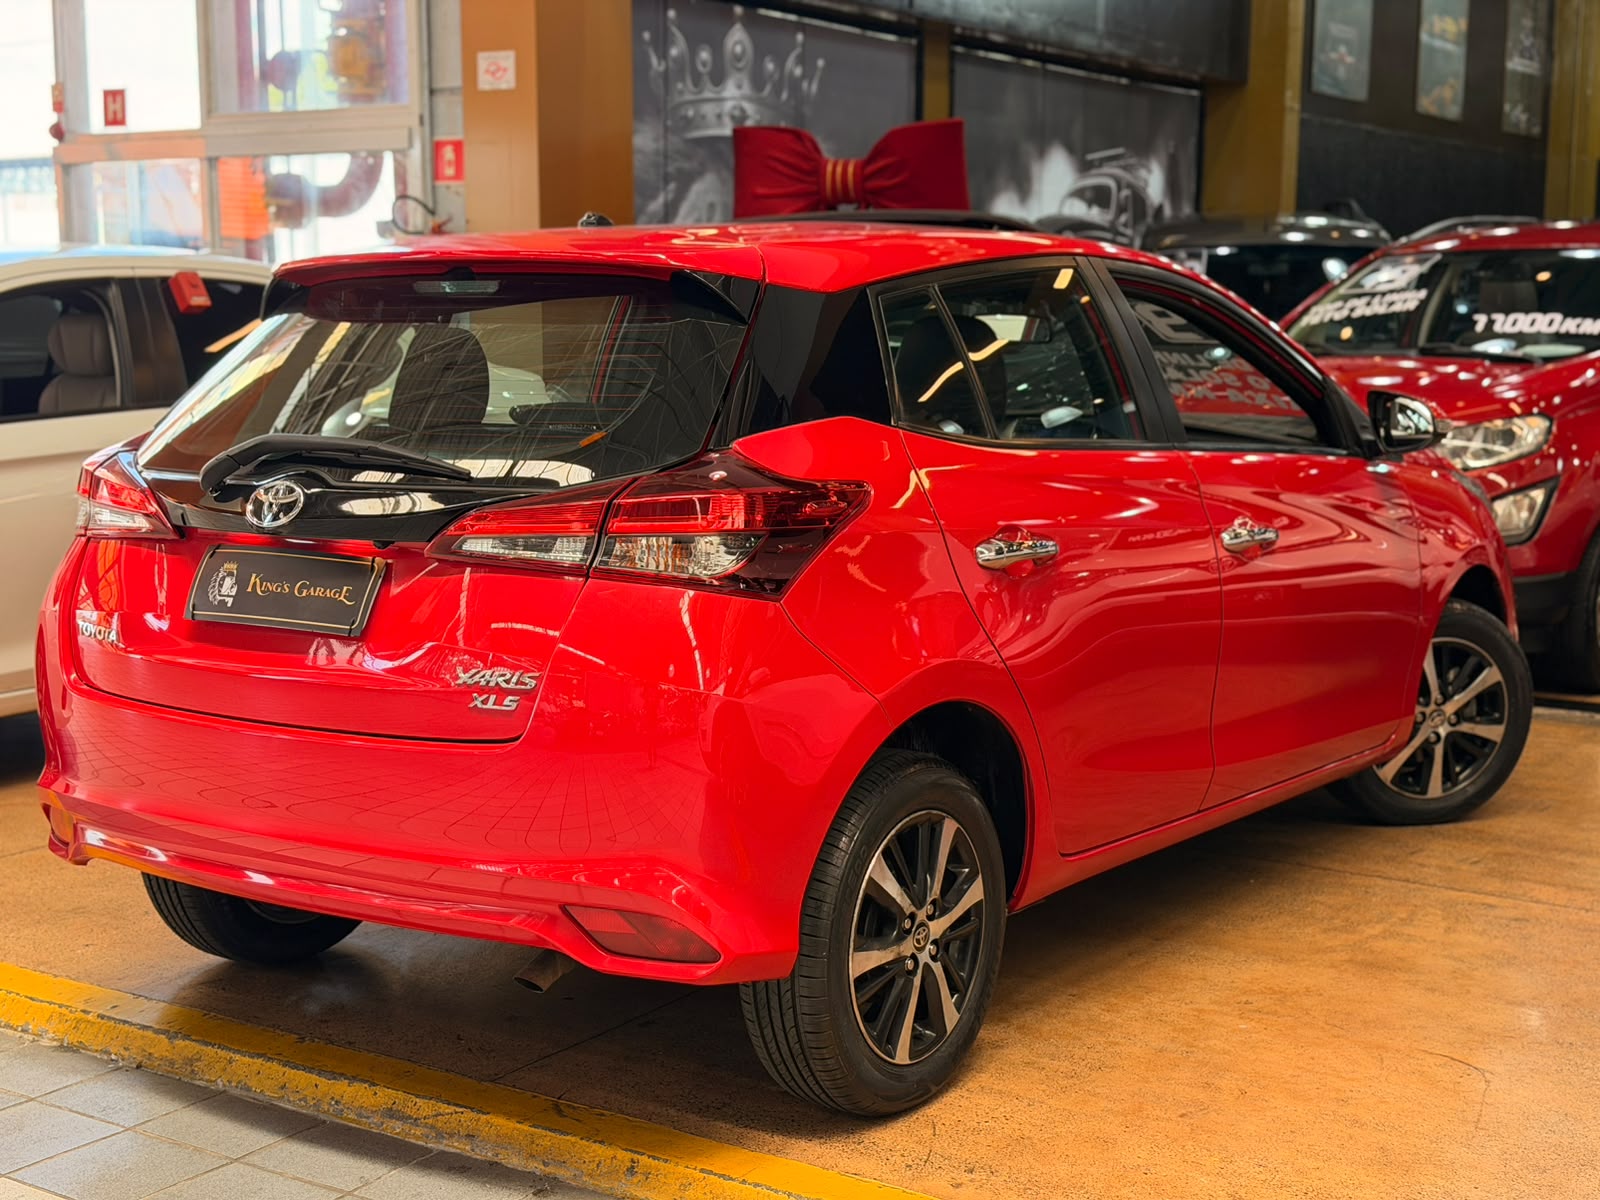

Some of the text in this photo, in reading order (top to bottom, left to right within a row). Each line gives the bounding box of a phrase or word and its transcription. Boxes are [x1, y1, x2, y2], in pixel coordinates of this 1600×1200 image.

[106, 93, 124, 123] H
[246, 573, 355, 605] KING'S GARAGE
[79, 621, 117, 644] TOYOTA
[455, 666, 543, 690] YARIS
[468, 693, 520, 711] XLS
